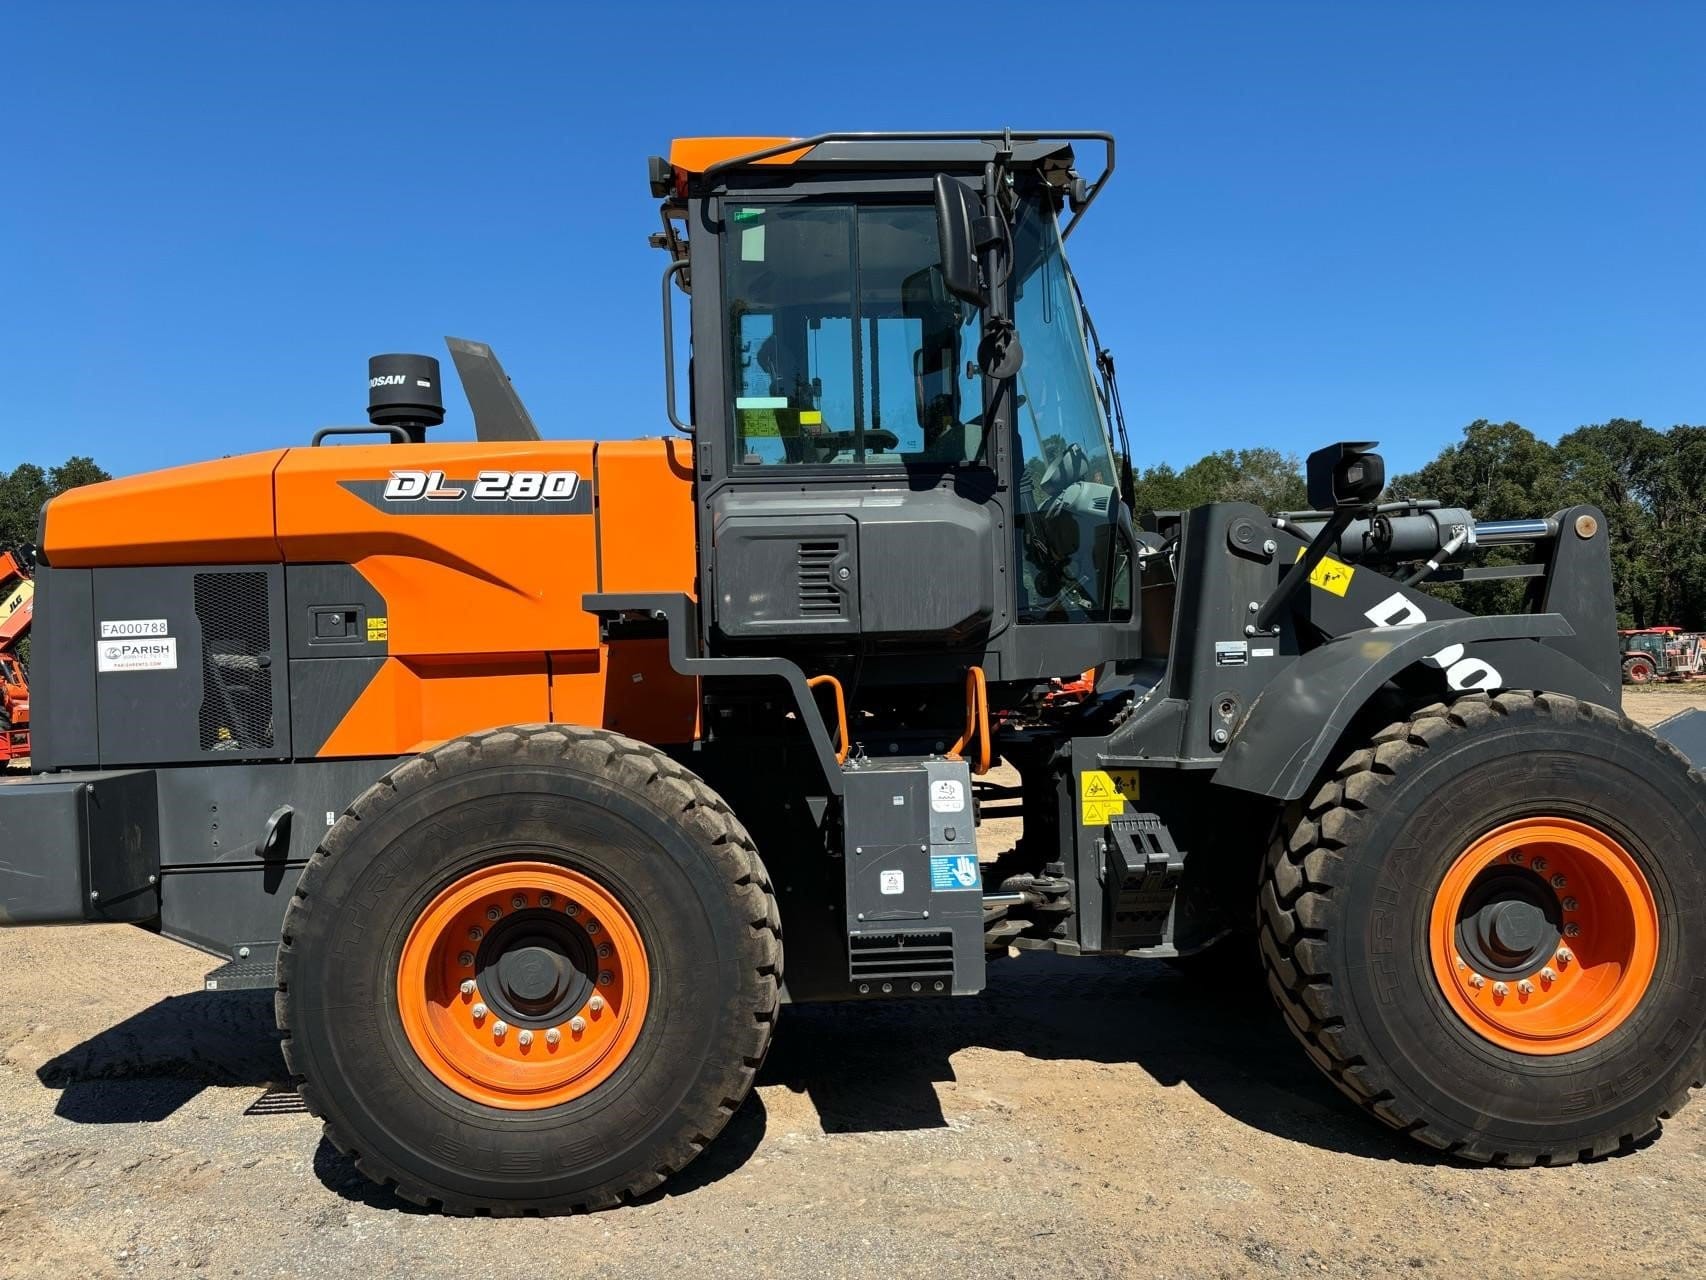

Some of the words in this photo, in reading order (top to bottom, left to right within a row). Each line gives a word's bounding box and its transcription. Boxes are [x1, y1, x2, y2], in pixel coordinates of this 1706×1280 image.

[384, 471, 466, 500] DL
[472, 471, 579, 500] 280
[9, 594, 23, 613] JLG
[102, 622, 166, 634] FA000788
